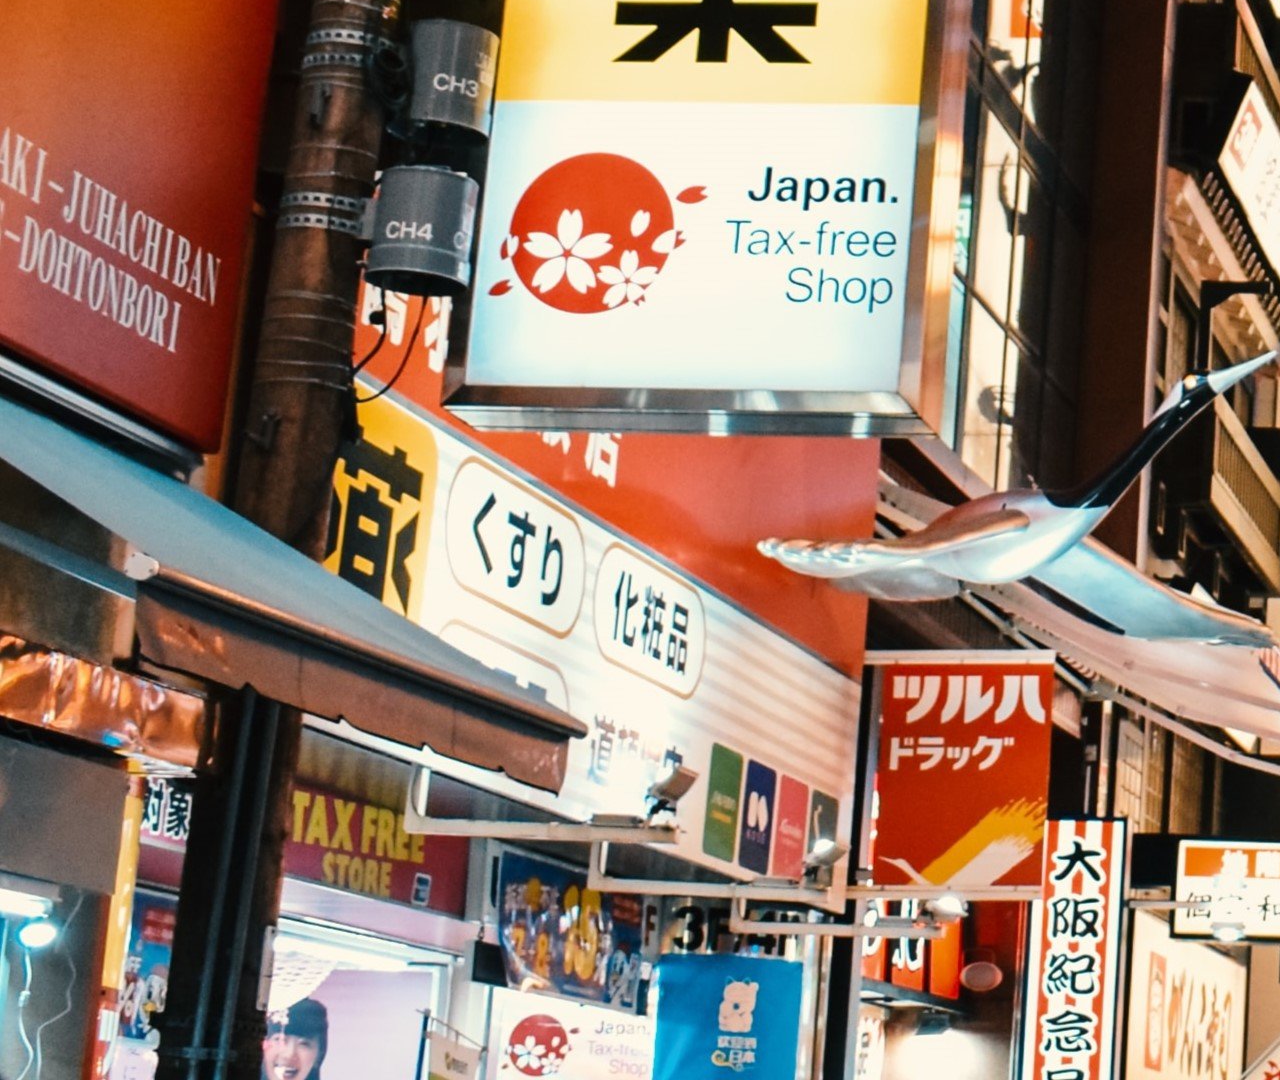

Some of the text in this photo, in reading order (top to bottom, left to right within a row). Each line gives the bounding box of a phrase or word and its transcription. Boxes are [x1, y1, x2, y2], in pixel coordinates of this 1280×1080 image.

[433, 73, 479, 98] CH3
[747, 167, 899, 210] Japan.
[385, 220, 434, 241] CH4
[726, 221, 897, 257] Tax-free
[785, 266, 893, 312] Shop
[471, 493, 565, 608] くすり
[613, 570, 691, 677] 化粧品
[892, 675, 1045, 724] ツルハ
[889, 735, 1014, 772] ドラッグ
[293, 790, 426, 863] TAX FREE
[322, 851, 393, 897] STORE
